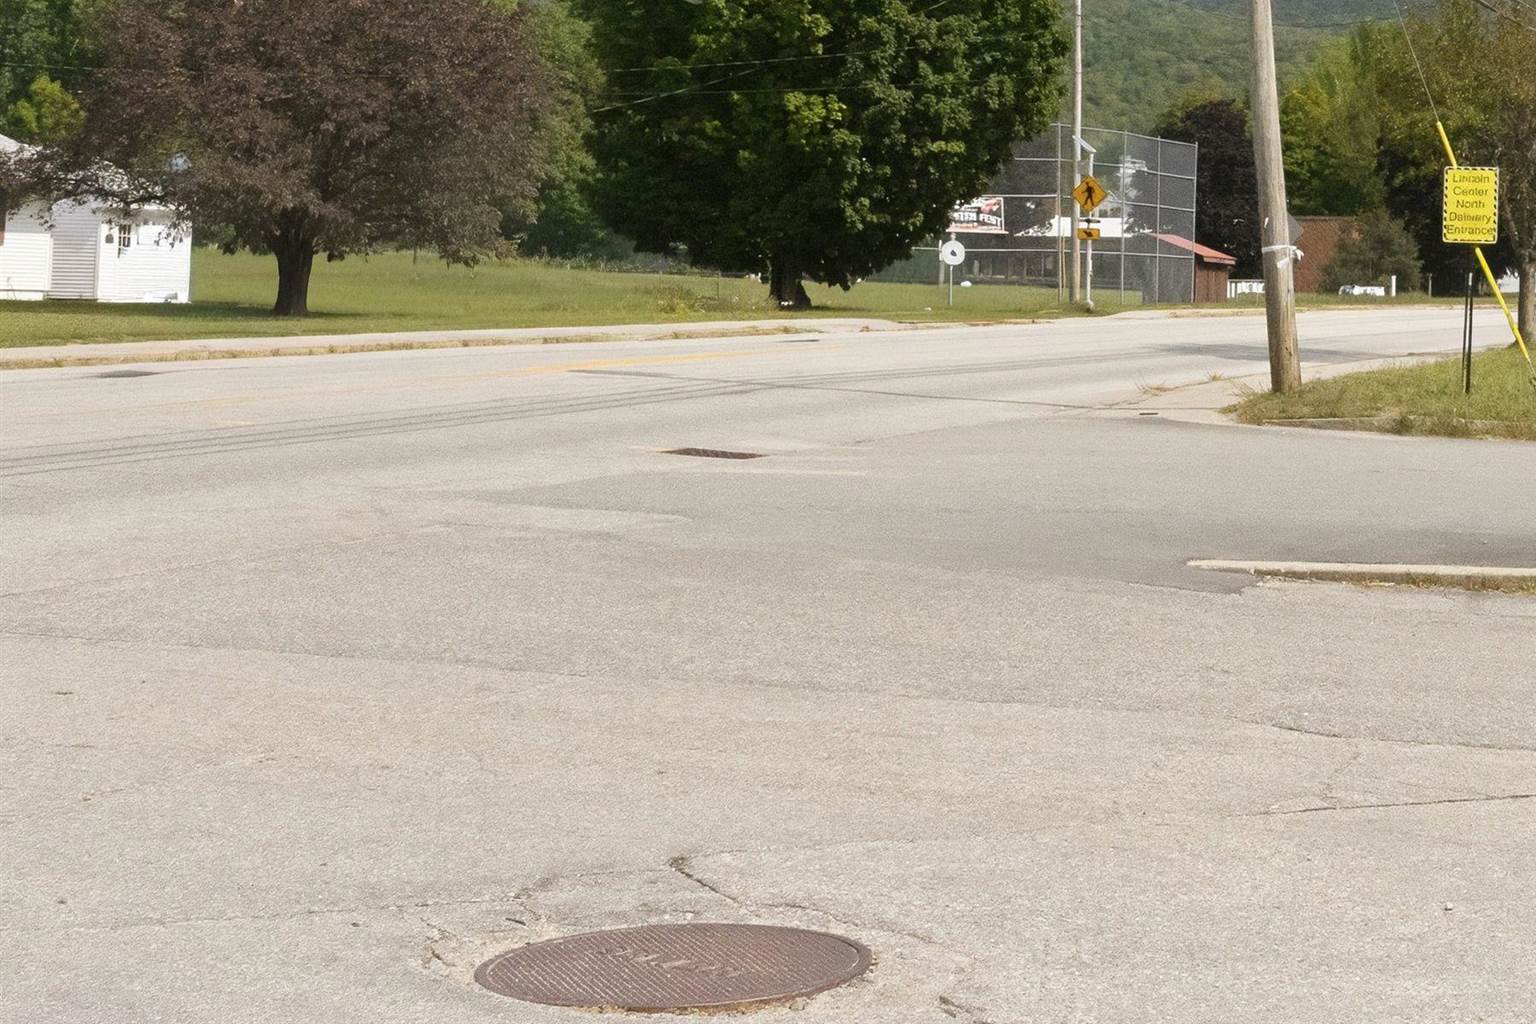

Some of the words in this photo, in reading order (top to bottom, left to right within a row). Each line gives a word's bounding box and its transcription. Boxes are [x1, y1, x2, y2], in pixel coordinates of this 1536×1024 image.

[1452, 173, 1490, 183] Lincoln
[1453, 186, 1489, 196] Center
[1456, 199, 1485, 209] North
[1446, 224, 1494, 235] Entrance
